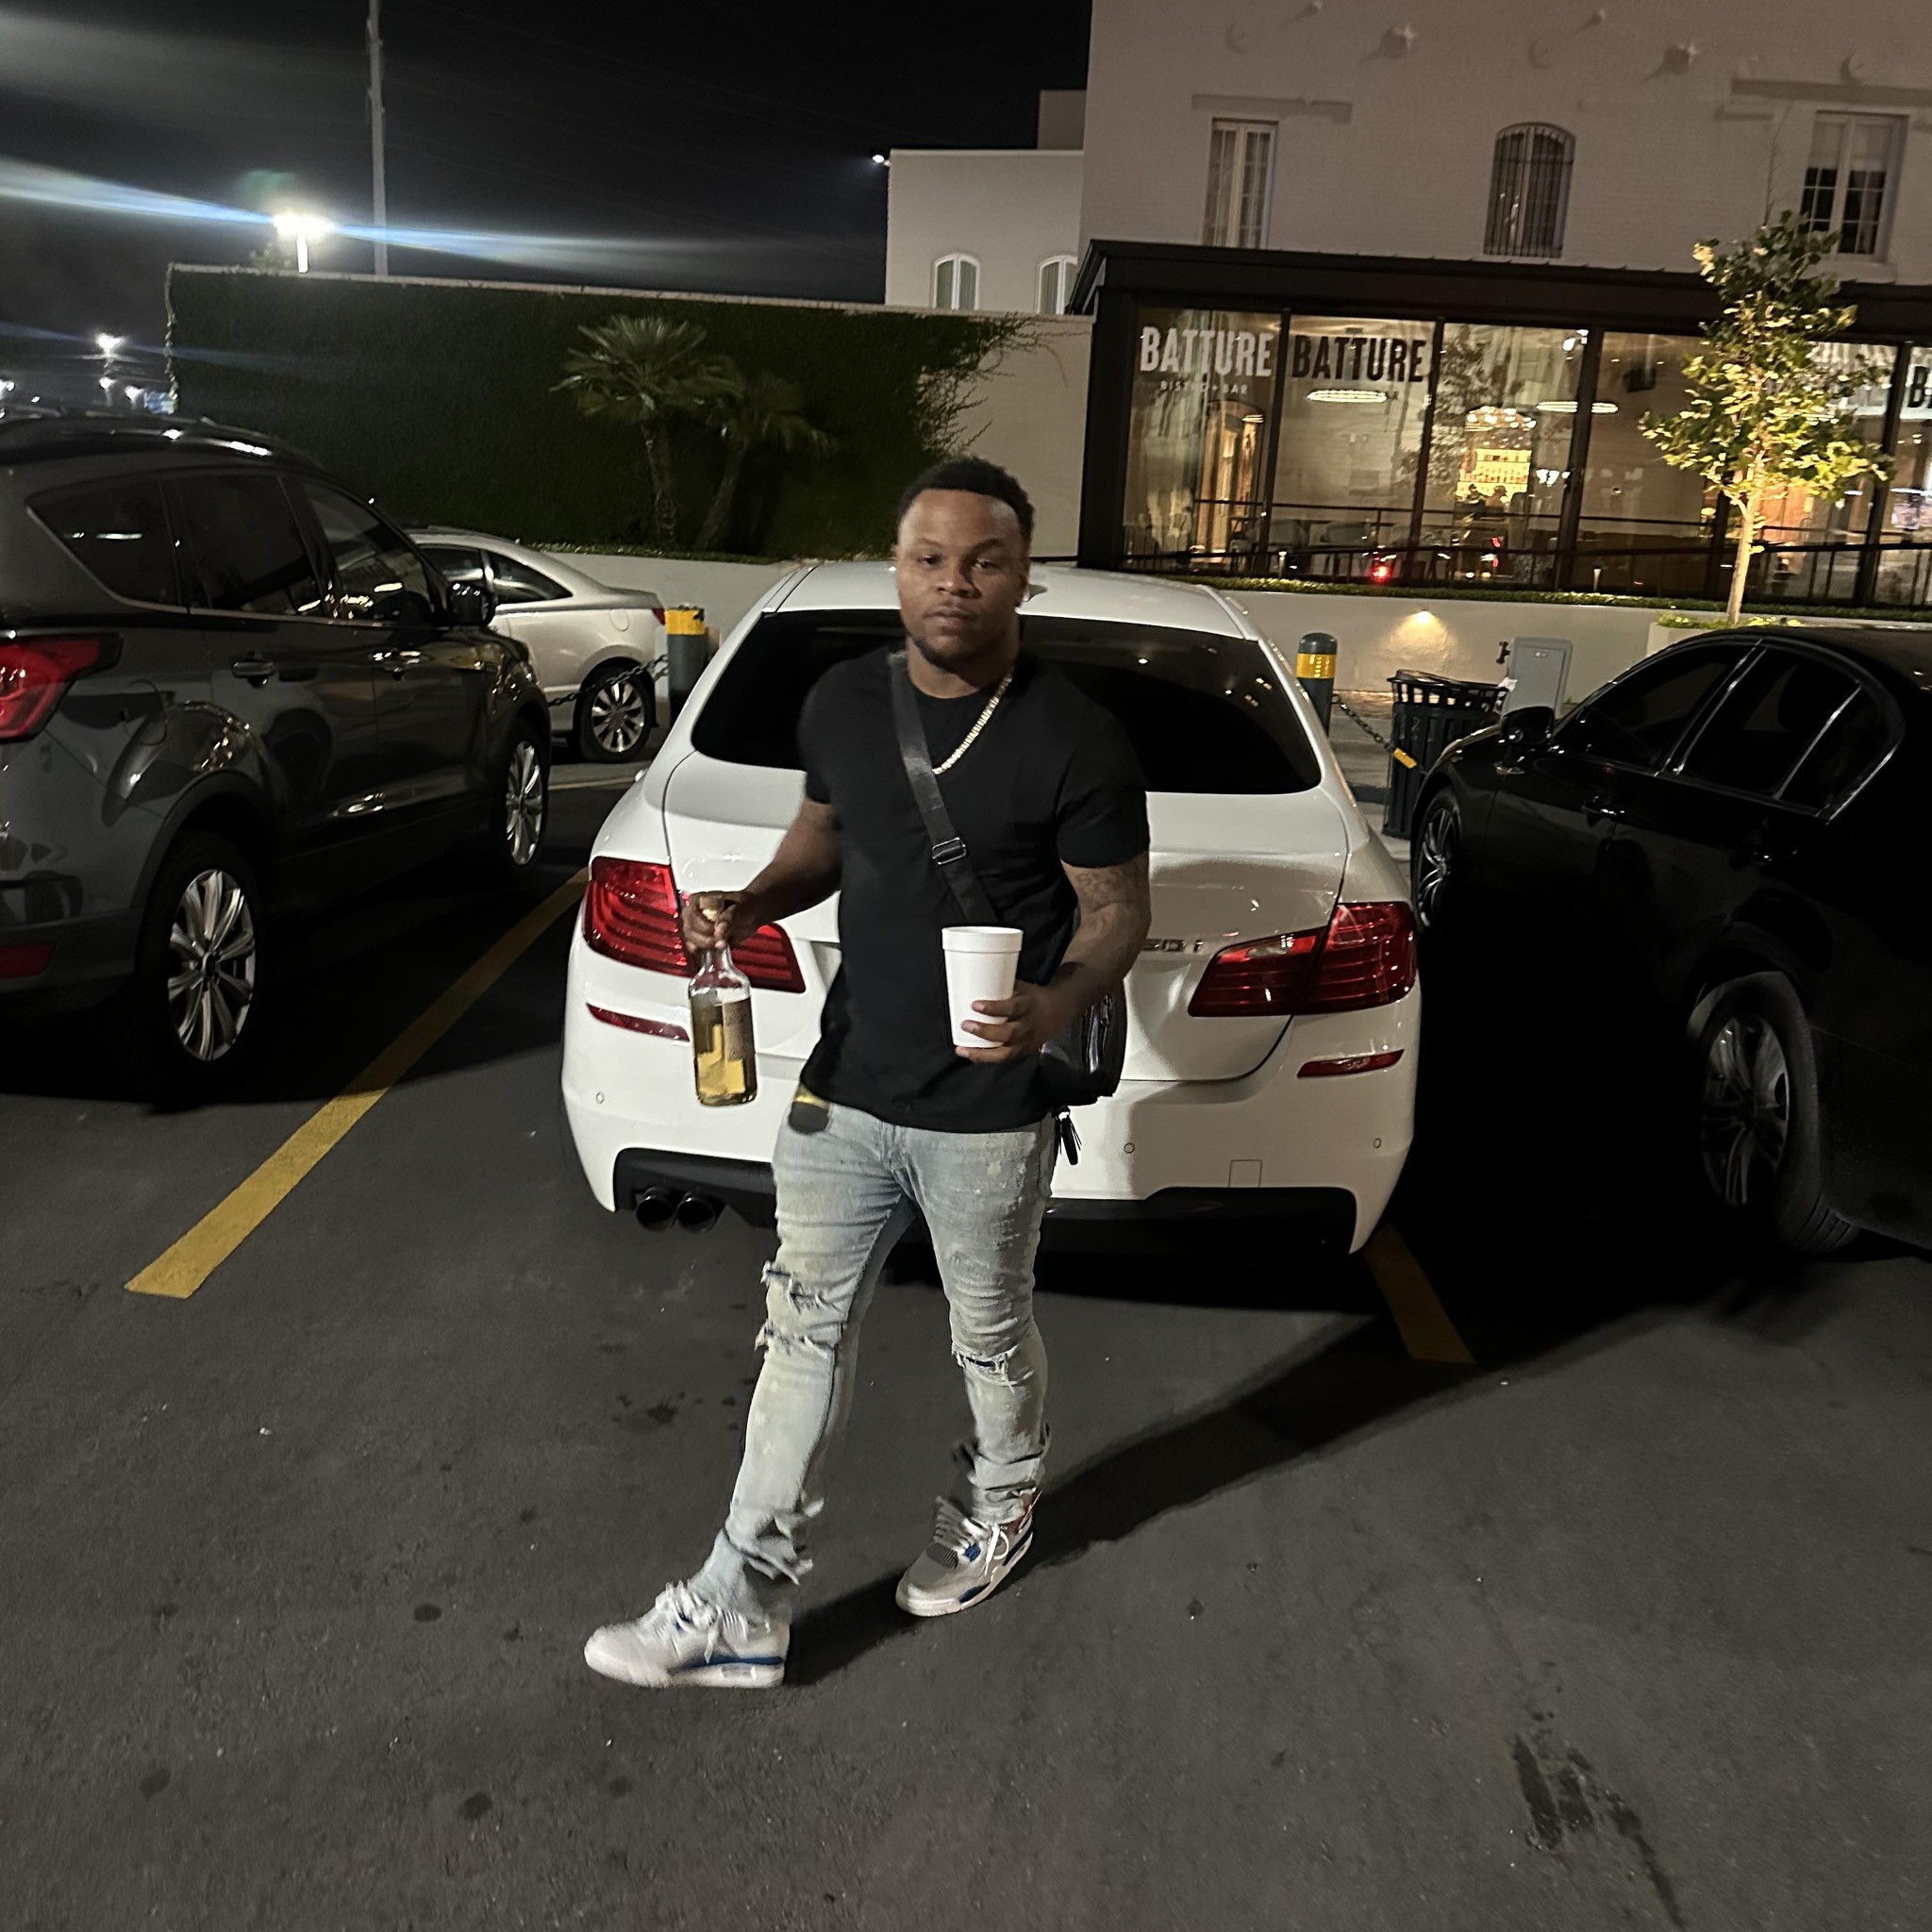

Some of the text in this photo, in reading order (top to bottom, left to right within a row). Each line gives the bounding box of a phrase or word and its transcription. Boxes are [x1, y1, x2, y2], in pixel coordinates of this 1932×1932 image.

[1140, 326, 1273, 377] BATTURE
[1291, 335, 1427, 383] BATTURE
[1223, 383, 1248, 394] BAR
[1907, 365, 1932, 408] B
